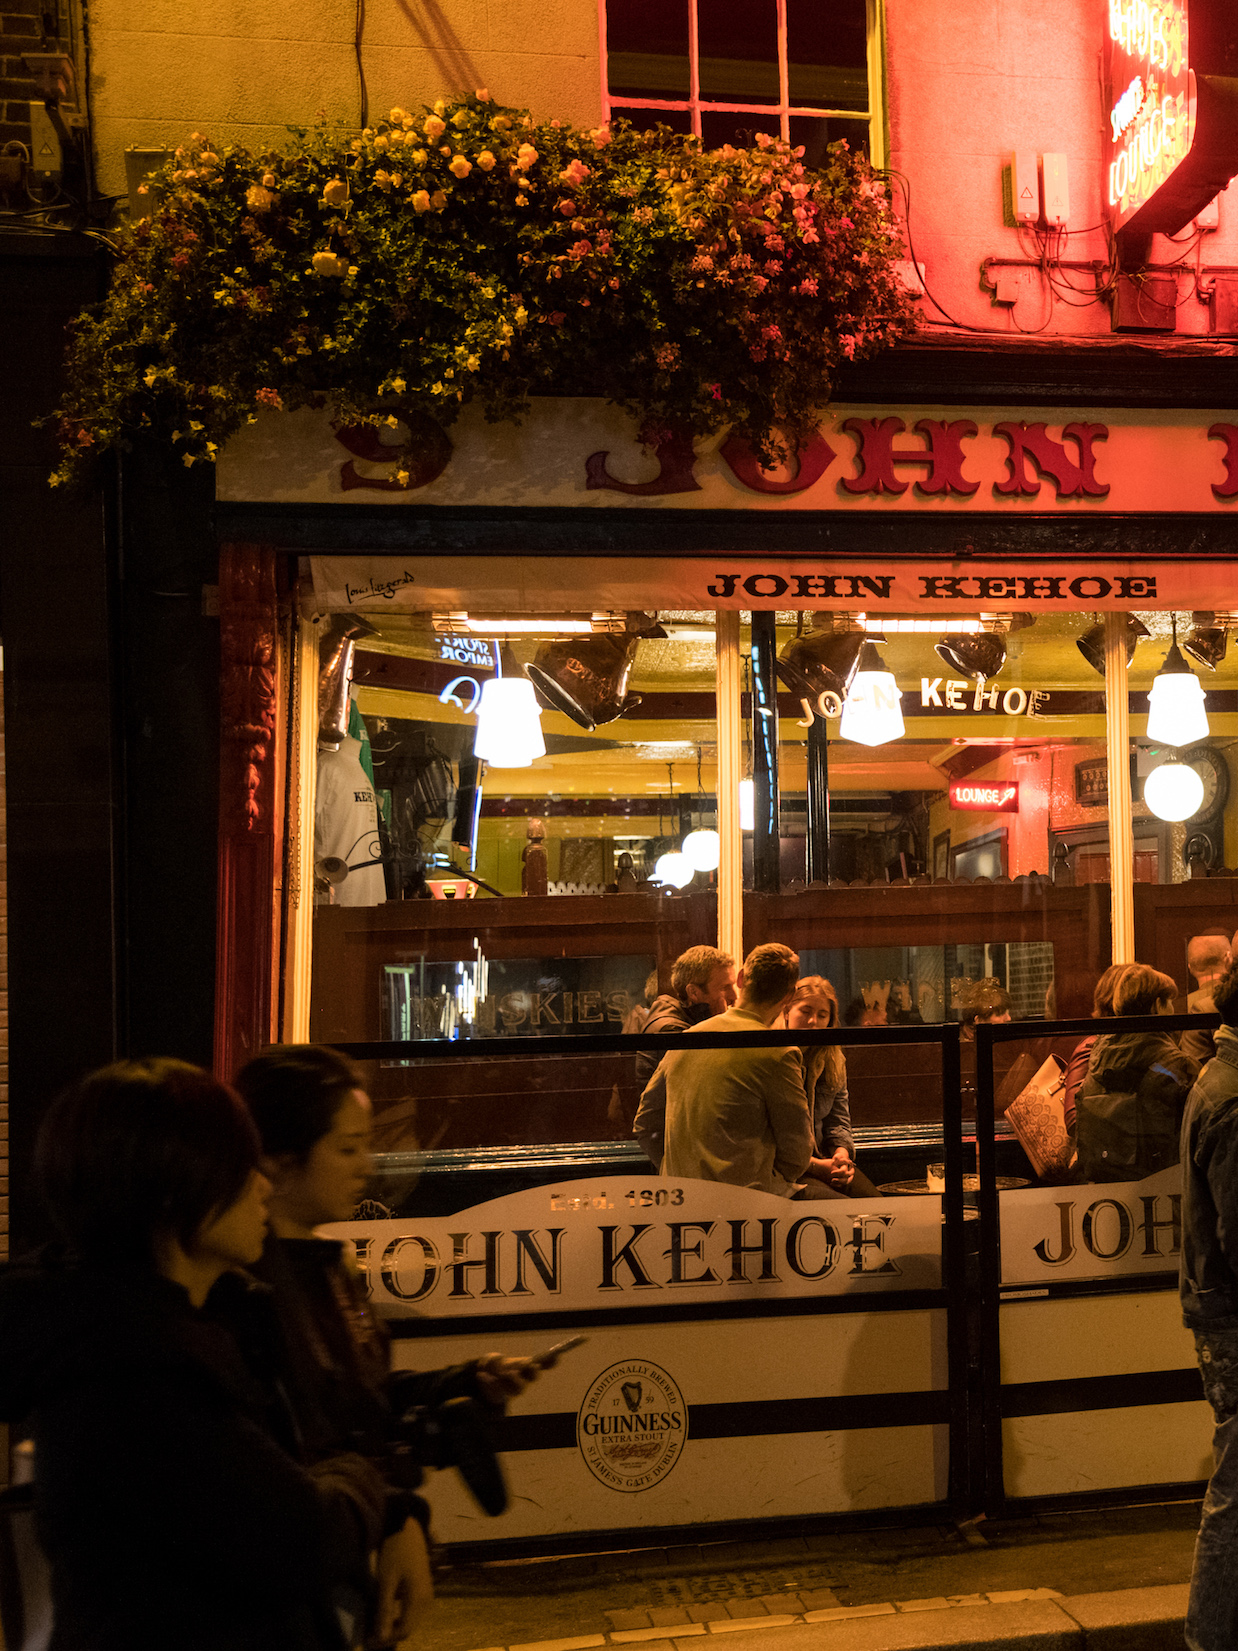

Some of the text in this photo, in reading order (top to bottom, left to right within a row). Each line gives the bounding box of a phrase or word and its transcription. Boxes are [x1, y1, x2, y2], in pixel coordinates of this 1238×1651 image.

[584, 412, 1111, 500] JOHN
[707, 574, 1158, 600] JOHN KEHOE
[920, 677, 1051, 722] KEHOE
[956, 787, 999, 803] LOUNGE
[624, 1188, 685, 1209] 1803
[597, 1213, 903, 1291] KEHOE
[1033, 1193, 1182, 1268] JOH
[588, 1365, 677, 1410] TRADITIONALLY BREWED
[583, 1411, 682, 1436] GUINNESS
[601, 1432, 664, 1444] EXTRA STOUT
[626, 1474, 653, 1487] GATE
[652, 1441, 678, 1476] DUBLIN
